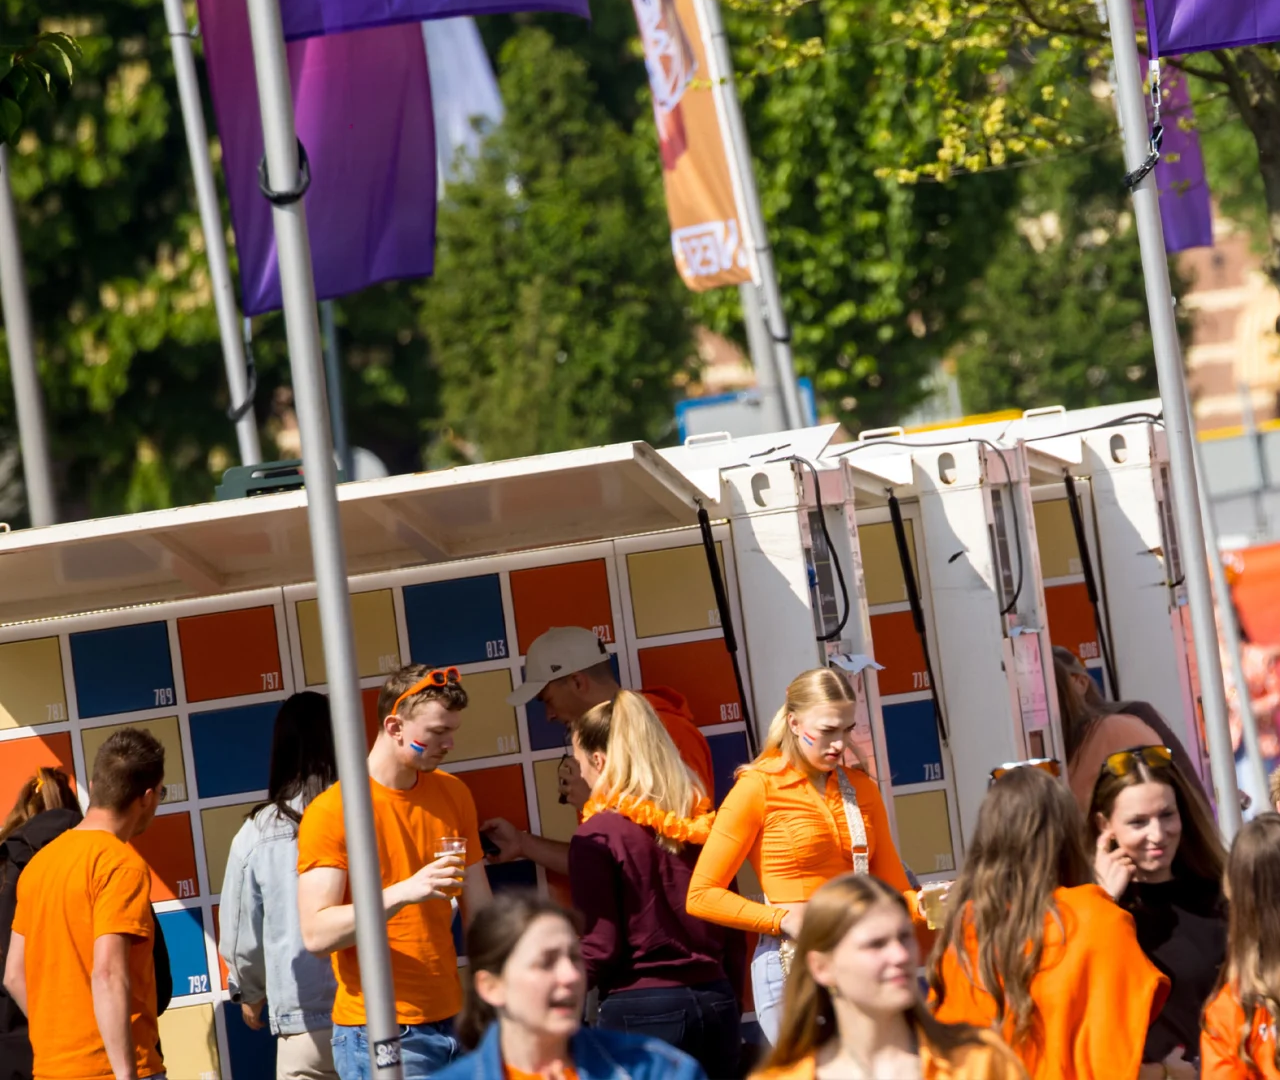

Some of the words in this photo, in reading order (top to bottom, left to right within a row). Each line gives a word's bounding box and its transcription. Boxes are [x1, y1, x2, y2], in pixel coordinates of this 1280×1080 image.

[708, 609, 722, 626] 82
[486, 639, 506, 658] 813
[260, 671, 279, 690] 797
[153, 687, 173, 706] 789
[46, 703, 64, 721] 781
[720, 702, 740, 721] 830
[923, 763, 941, 780] 719
[176, 878, 196, 898] 791
[188, 974, 208, 994] 792
